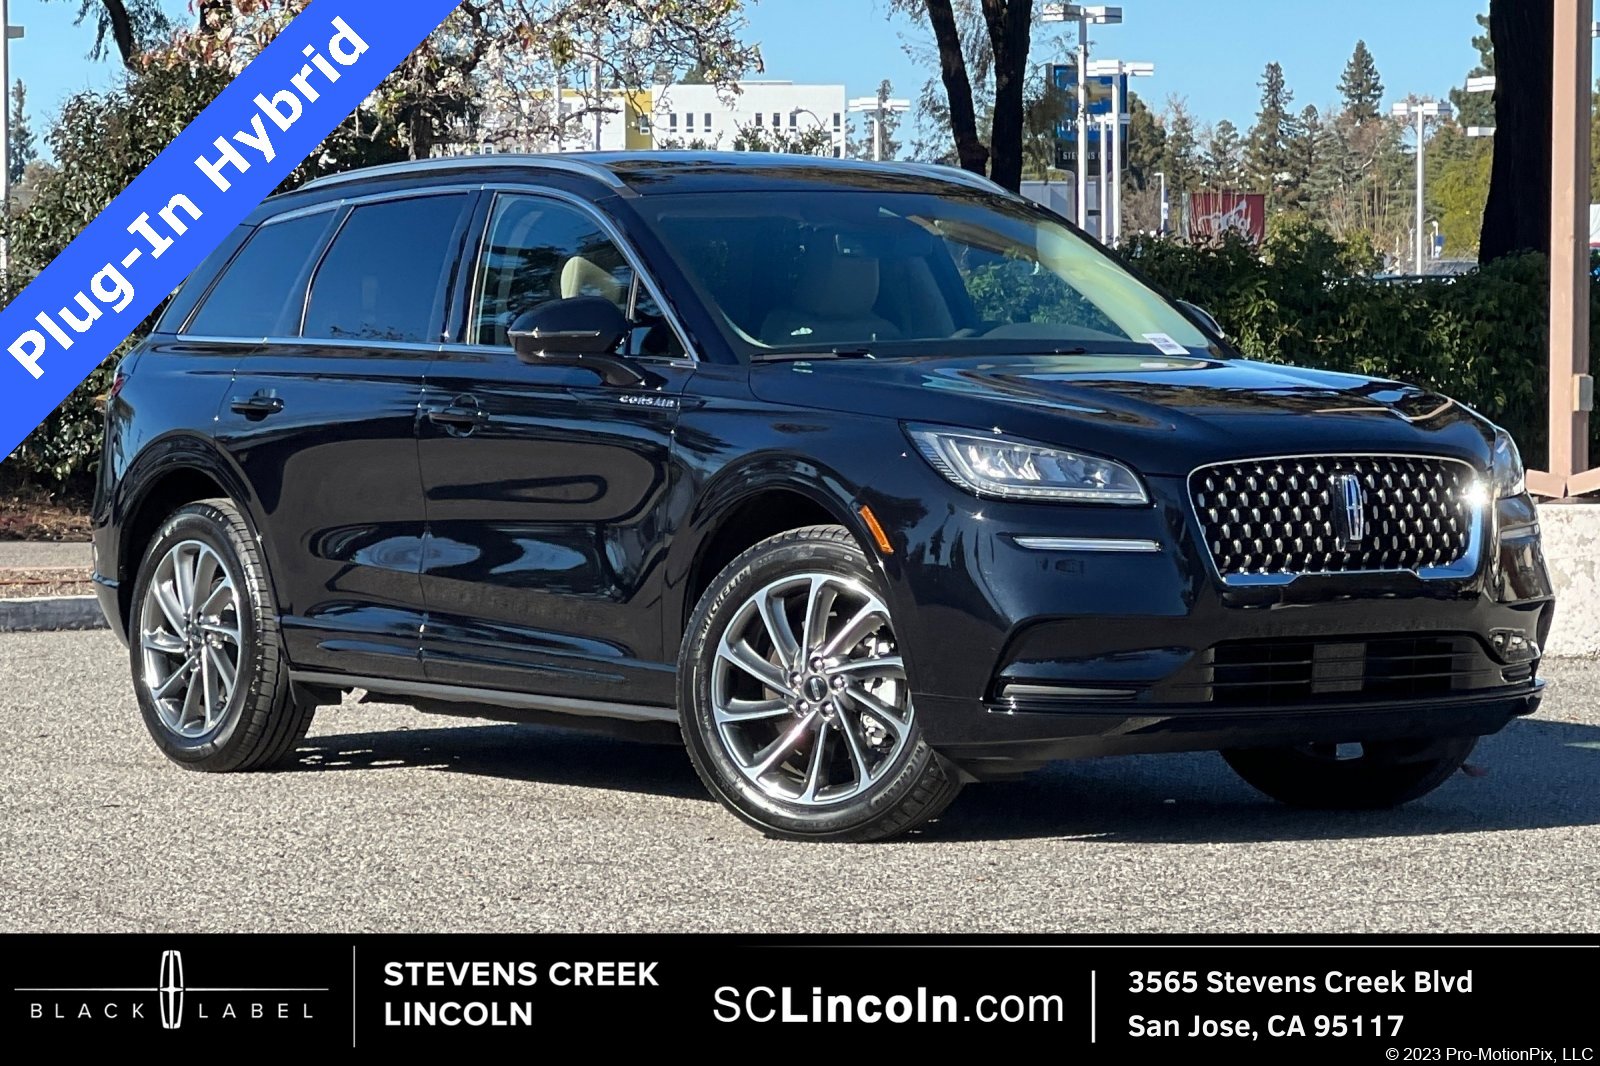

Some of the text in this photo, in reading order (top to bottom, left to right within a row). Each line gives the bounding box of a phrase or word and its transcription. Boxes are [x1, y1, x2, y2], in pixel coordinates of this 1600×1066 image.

[1062, 151, 1096, 160] STENS
[619, 395, 674, 408] CORSAIR
[699, 565, 750, 634] MICHELIN
